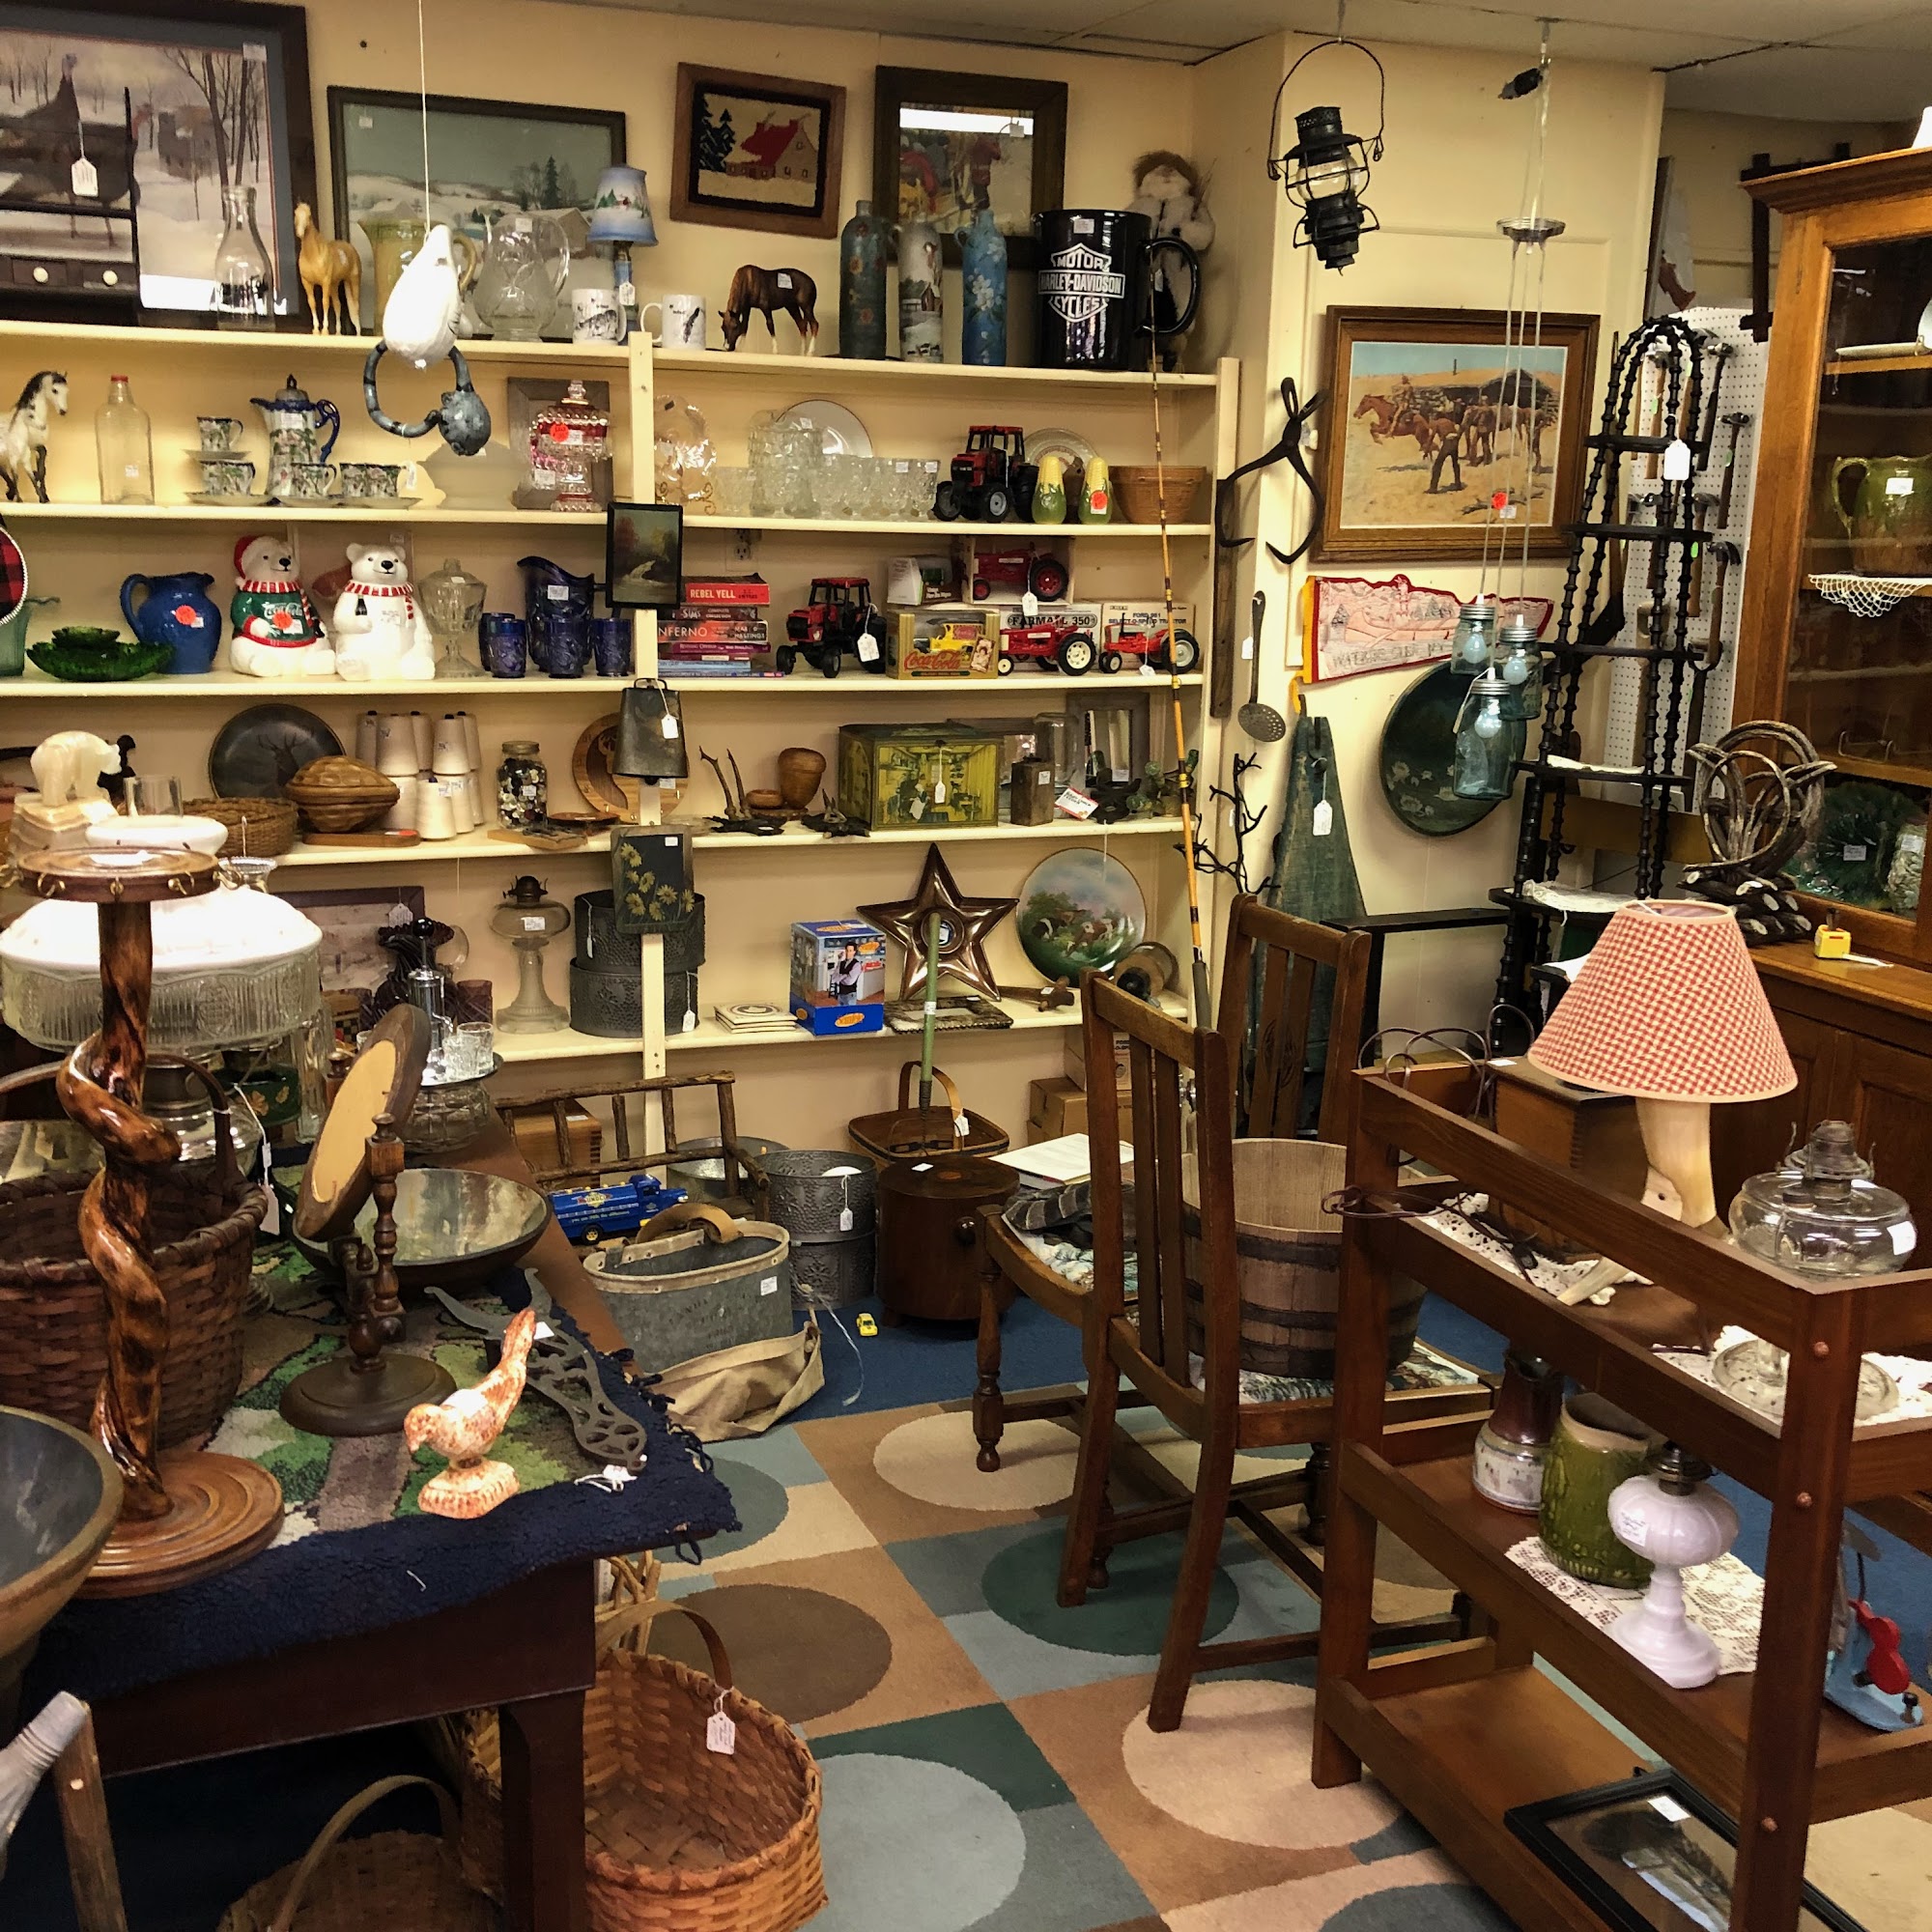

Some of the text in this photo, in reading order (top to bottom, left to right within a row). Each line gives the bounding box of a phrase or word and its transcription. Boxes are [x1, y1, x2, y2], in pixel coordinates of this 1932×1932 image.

[1057, 248, 1103, 270] MOTOR
[1040, 272, 1122, 294] HARLEY-DAVIDSON
[1054, 296, 1100, 318] CYCLES
[690, 588, 714, 599] REBEL
[716, 588, 736, 599] YELL
[1011, 615, 1091, 626] FARMAL 350
[658, 626, 708, 638] NFERNO
